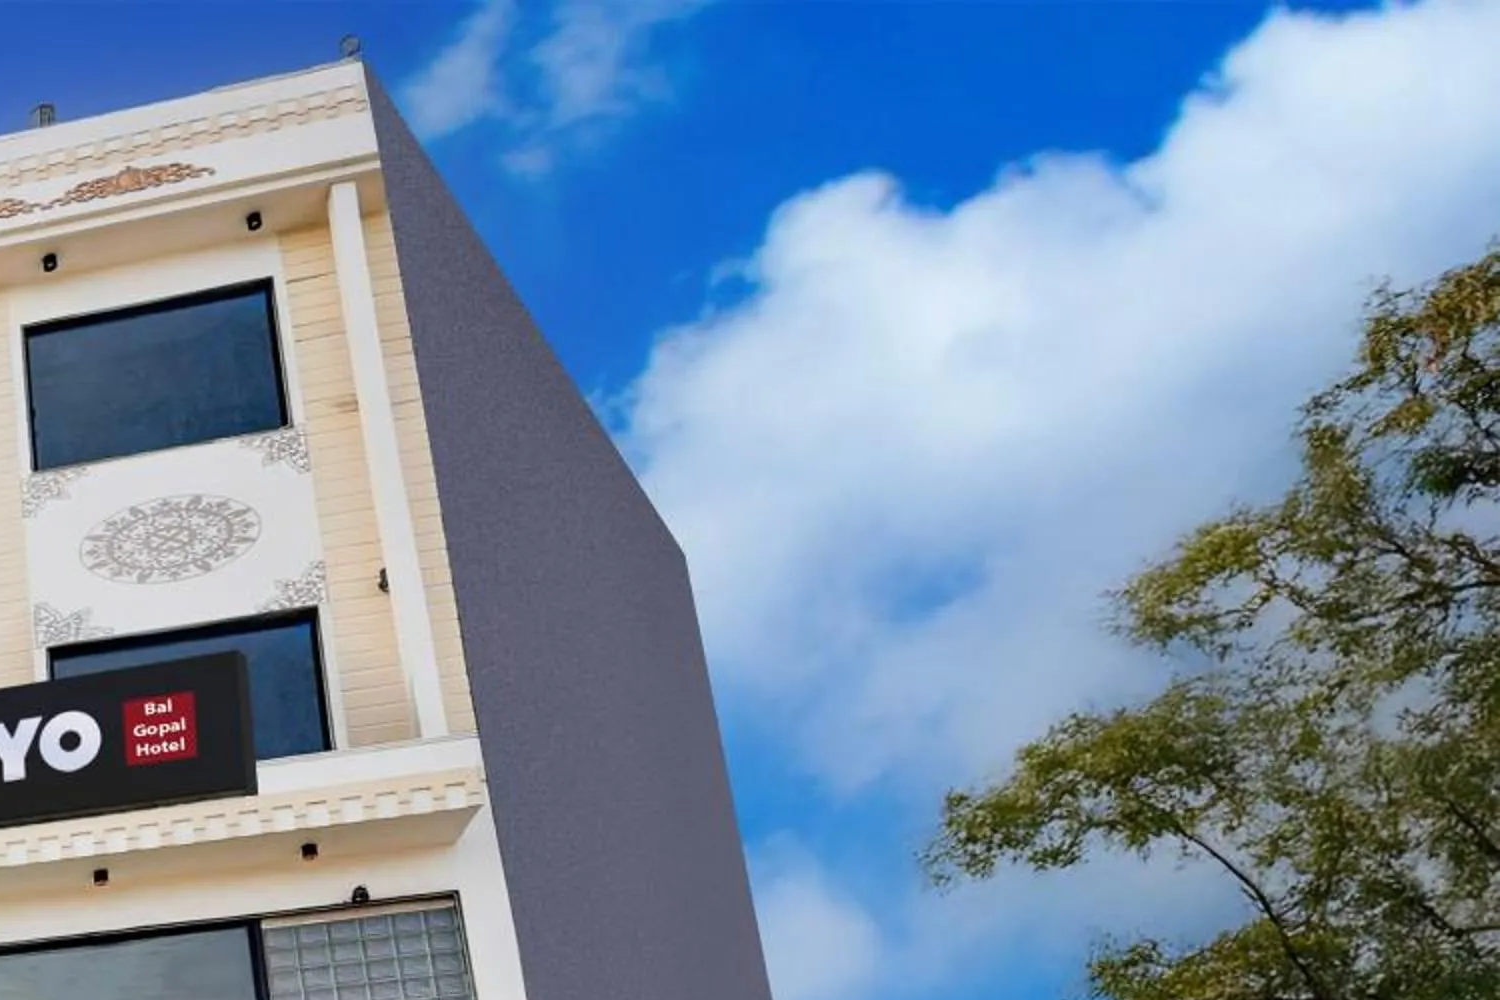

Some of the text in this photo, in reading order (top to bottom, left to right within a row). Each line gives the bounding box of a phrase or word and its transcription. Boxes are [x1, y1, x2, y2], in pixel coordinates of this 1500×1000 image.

[144, 697, 173, 716] Bal
[133, 717, 186, 737] Gopal
[136, 736, 185, 757] Hotel
